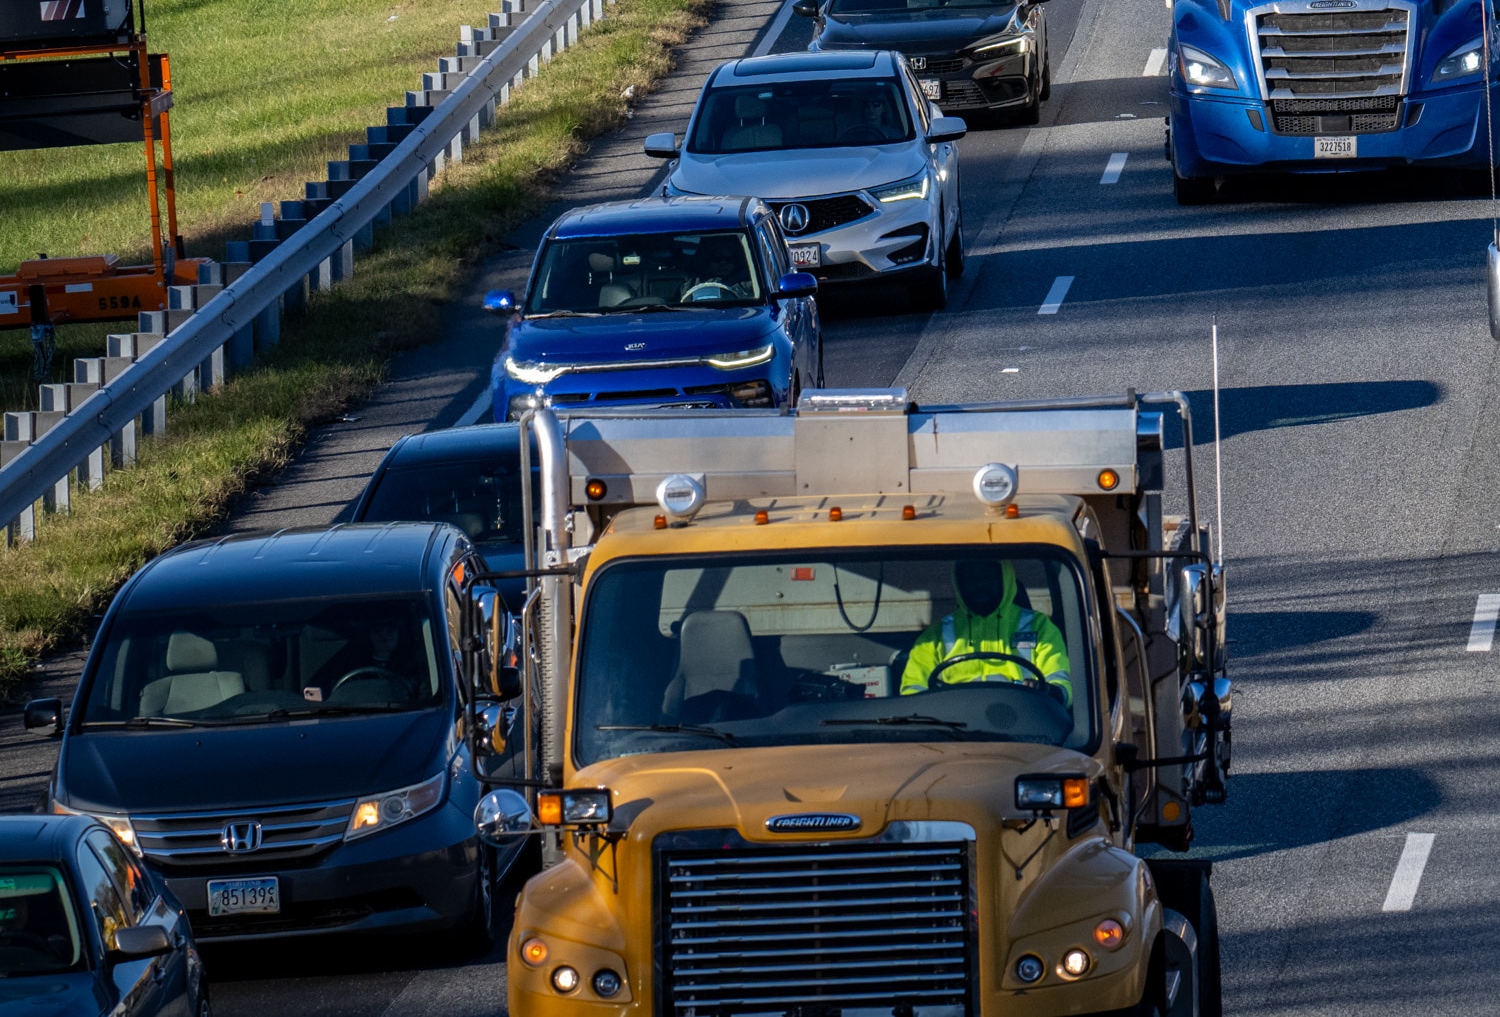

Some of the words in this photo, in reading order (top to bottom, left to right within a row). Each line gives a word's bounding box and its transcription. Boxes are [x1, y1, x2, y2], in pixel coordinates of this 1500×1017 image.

[1320, 141, 1352, 152] 3227518
[98, 295, 142, 311] 559A
[776, 816, 852, 827] FREIGHTLINER
[221, 887, 266, 906] 85139
